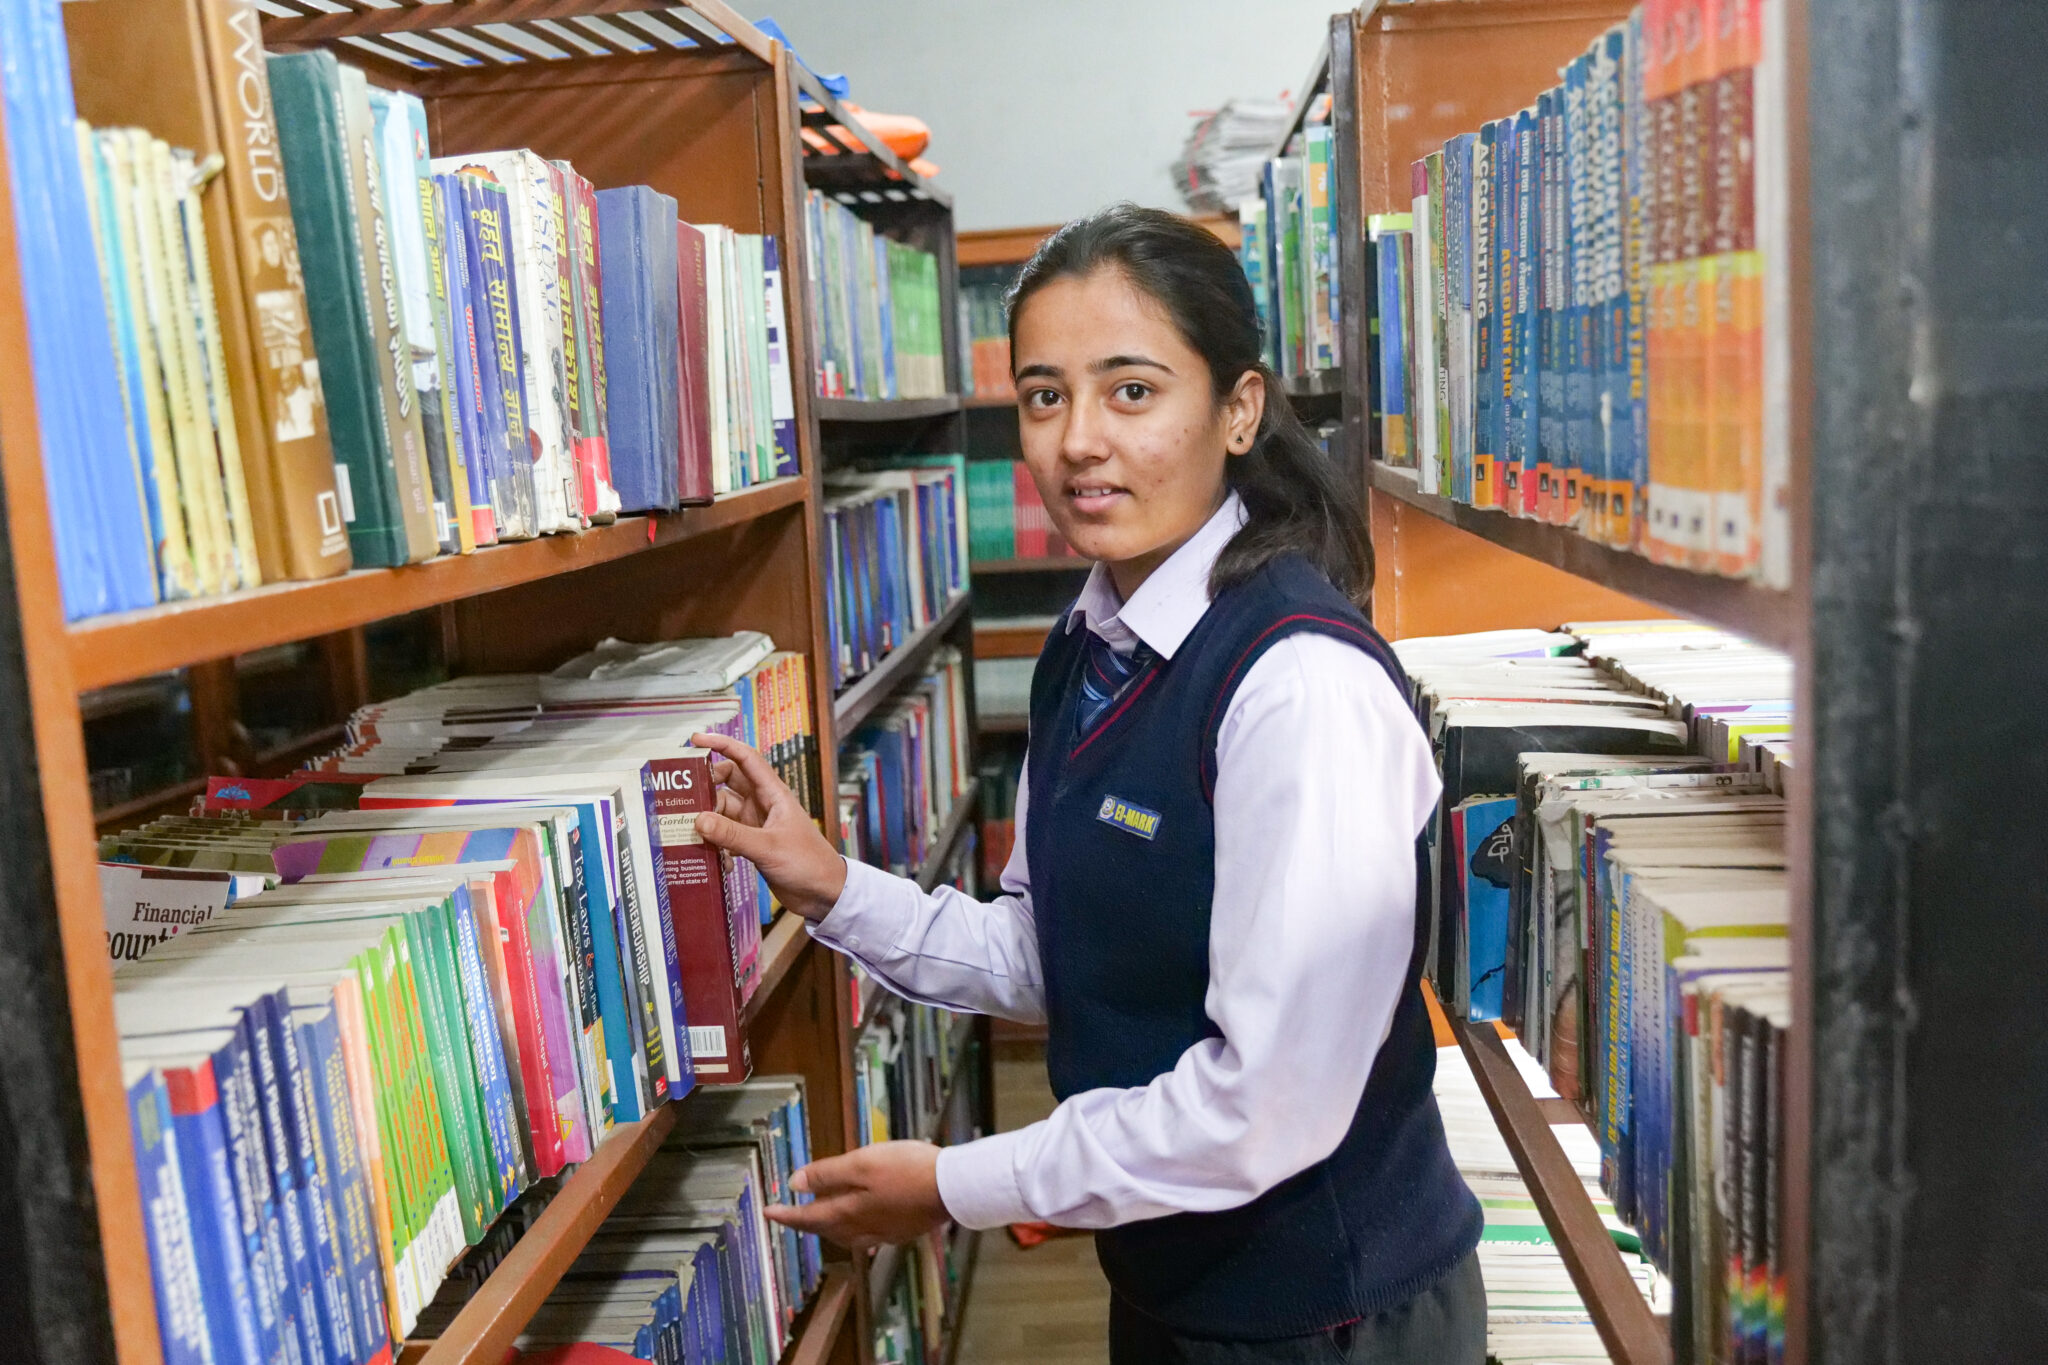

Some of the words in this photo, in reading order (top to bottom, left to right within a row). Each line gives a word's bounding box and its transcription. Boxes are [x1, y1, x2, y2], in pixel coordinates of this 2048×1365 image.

[227, 8, 279, 202] WORLD
[1477, 143, 1490, 320] ACCOUNTING
[1501, 184, 1509, 243] Management
[1501, 248, 1514, 398] ACCOUNTING
[489, 279, 518, 379] सामान्य
[504, 388, 526, 443] ज्ञान
[665, 798, 695, 807] Edition
[574, 850, 585, 891] Tax
[132, 902, 213, 925] Financial
[518, 899, 528, 947] Business
[578, 891, 591, 949] Laws
[620, 847, 650, 985] ENTREPRENEURSHIP
[654, 852, 679, 966] MICROECONOMICS
[1610, 908, 1621, 953] BOOK
[526, 949, 541, 1020] Environment
[585, 952, 595, 969] &
[1610, 953, 1620, 975] OF
[537, 1022, 542, 1034] in
[1609, 975, 1619, 1043] PHYSICS
[1619, 967, 1631, 1043] EXAMPLES
[539, 1035, 549, 1070] Nepal
[680, 1024, 692, 1075] PEARSON
[1608, 1043, 1619, 1075] FOR
[1619, 1045, 1628, 1063] IN
[1607, 1075, 1618, 1126] CLASS
[1617, 1064, 1627, 1124] PHYSICS
[256, 1027, 275, 1085] Profit
[266, 1084, 289, 1175] Planning
[284, 1188, 306, 1262] Control
[281, 1015, 299, 1071] Profit
[291, 1070, 313, 1159] Planning
[309, 1173, 329, 1245] Control
